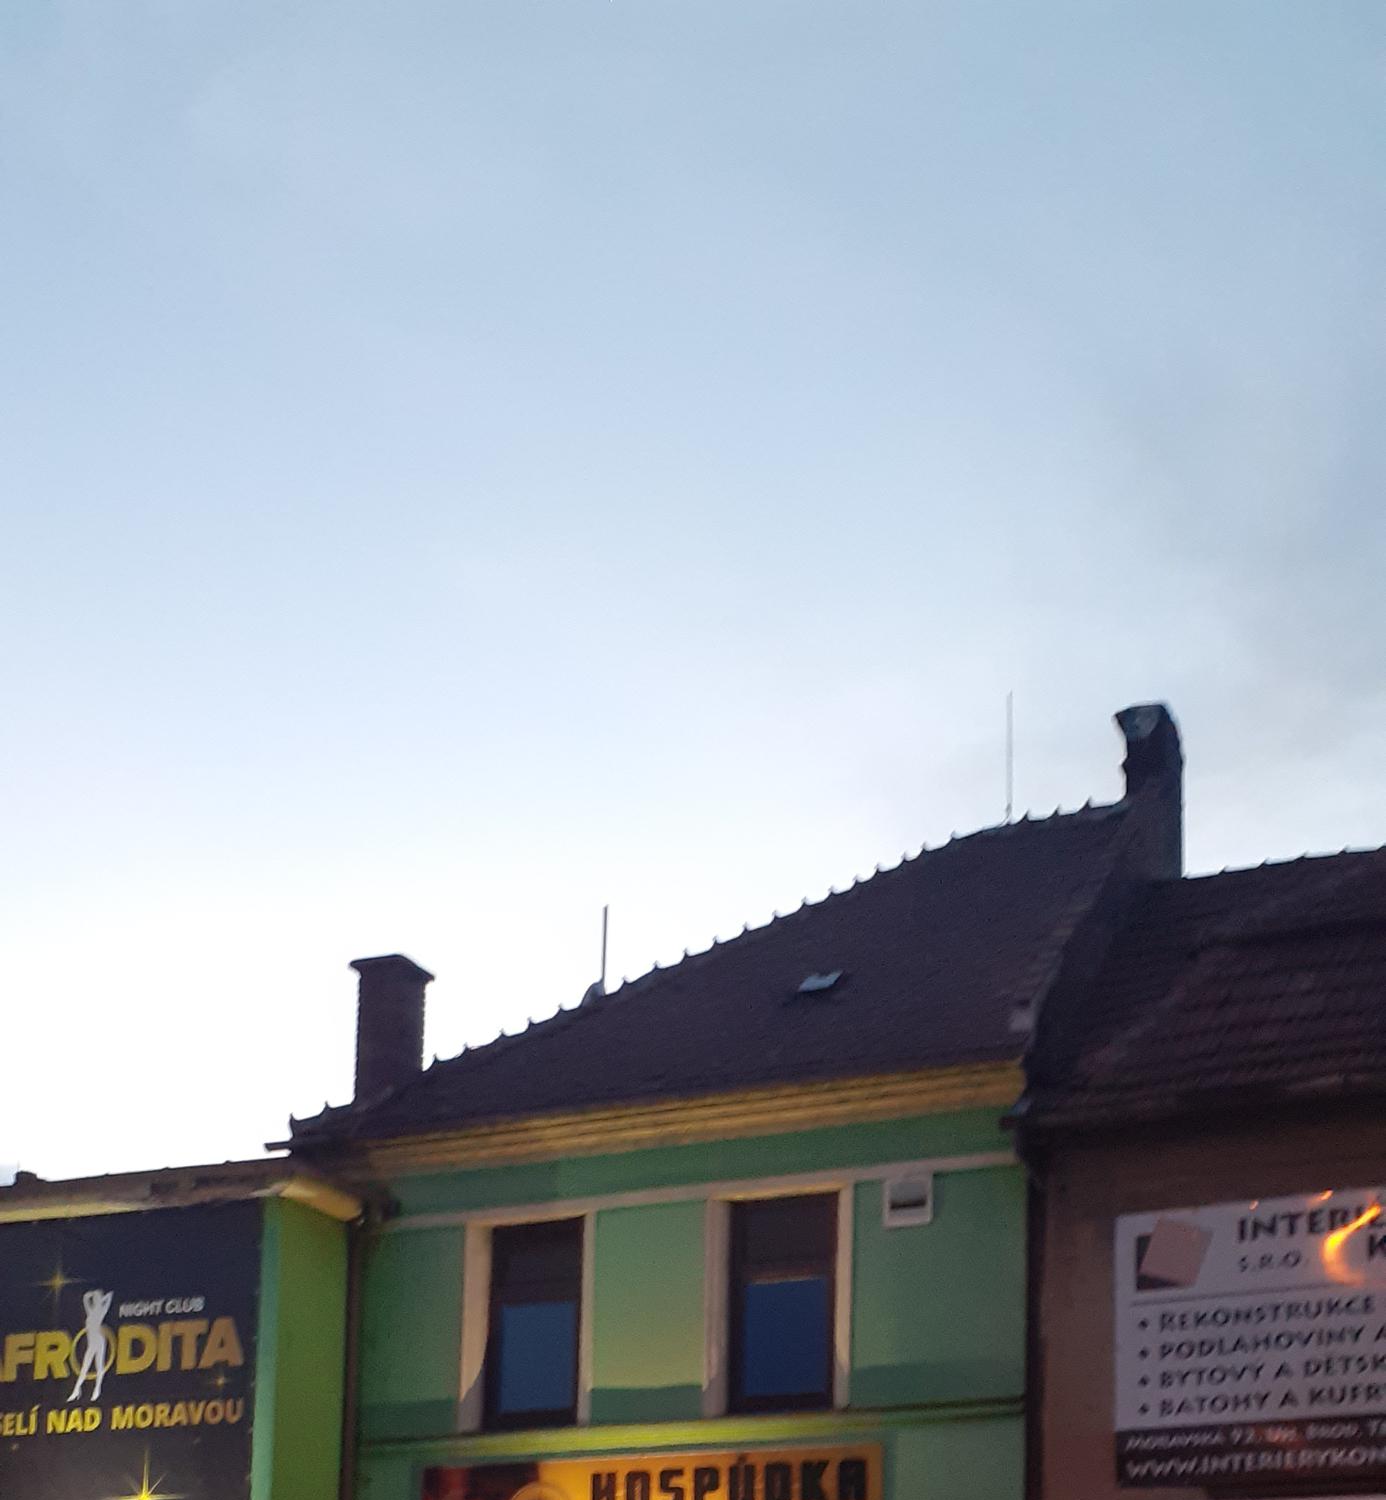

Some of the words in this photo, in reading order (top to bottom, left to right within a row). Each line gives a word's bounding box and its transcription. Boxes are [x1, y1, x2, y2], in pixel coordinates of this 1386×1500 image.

[119, 1300, 162, 1318] NIGHT
[164, 1297, 206, 1315] CLUB
[1159, 1296, 1375, 1331] REKONSTRUKCE
[0, 1316, 244, 1382] FRODITA
[1159, 1325, 1366, 1360] PODLAHOVINY
[1274, 1361, 1295, 1379] A
[46, 1406, 101, 1434] NAD
[111, 1397, 244, 1431] MORAVOU
[1159, 1390, 1272, 1418] BATOHY
[1279, 1388, 1301, 1408] A
[1309, 1383, 1386, 1405] KUFR
